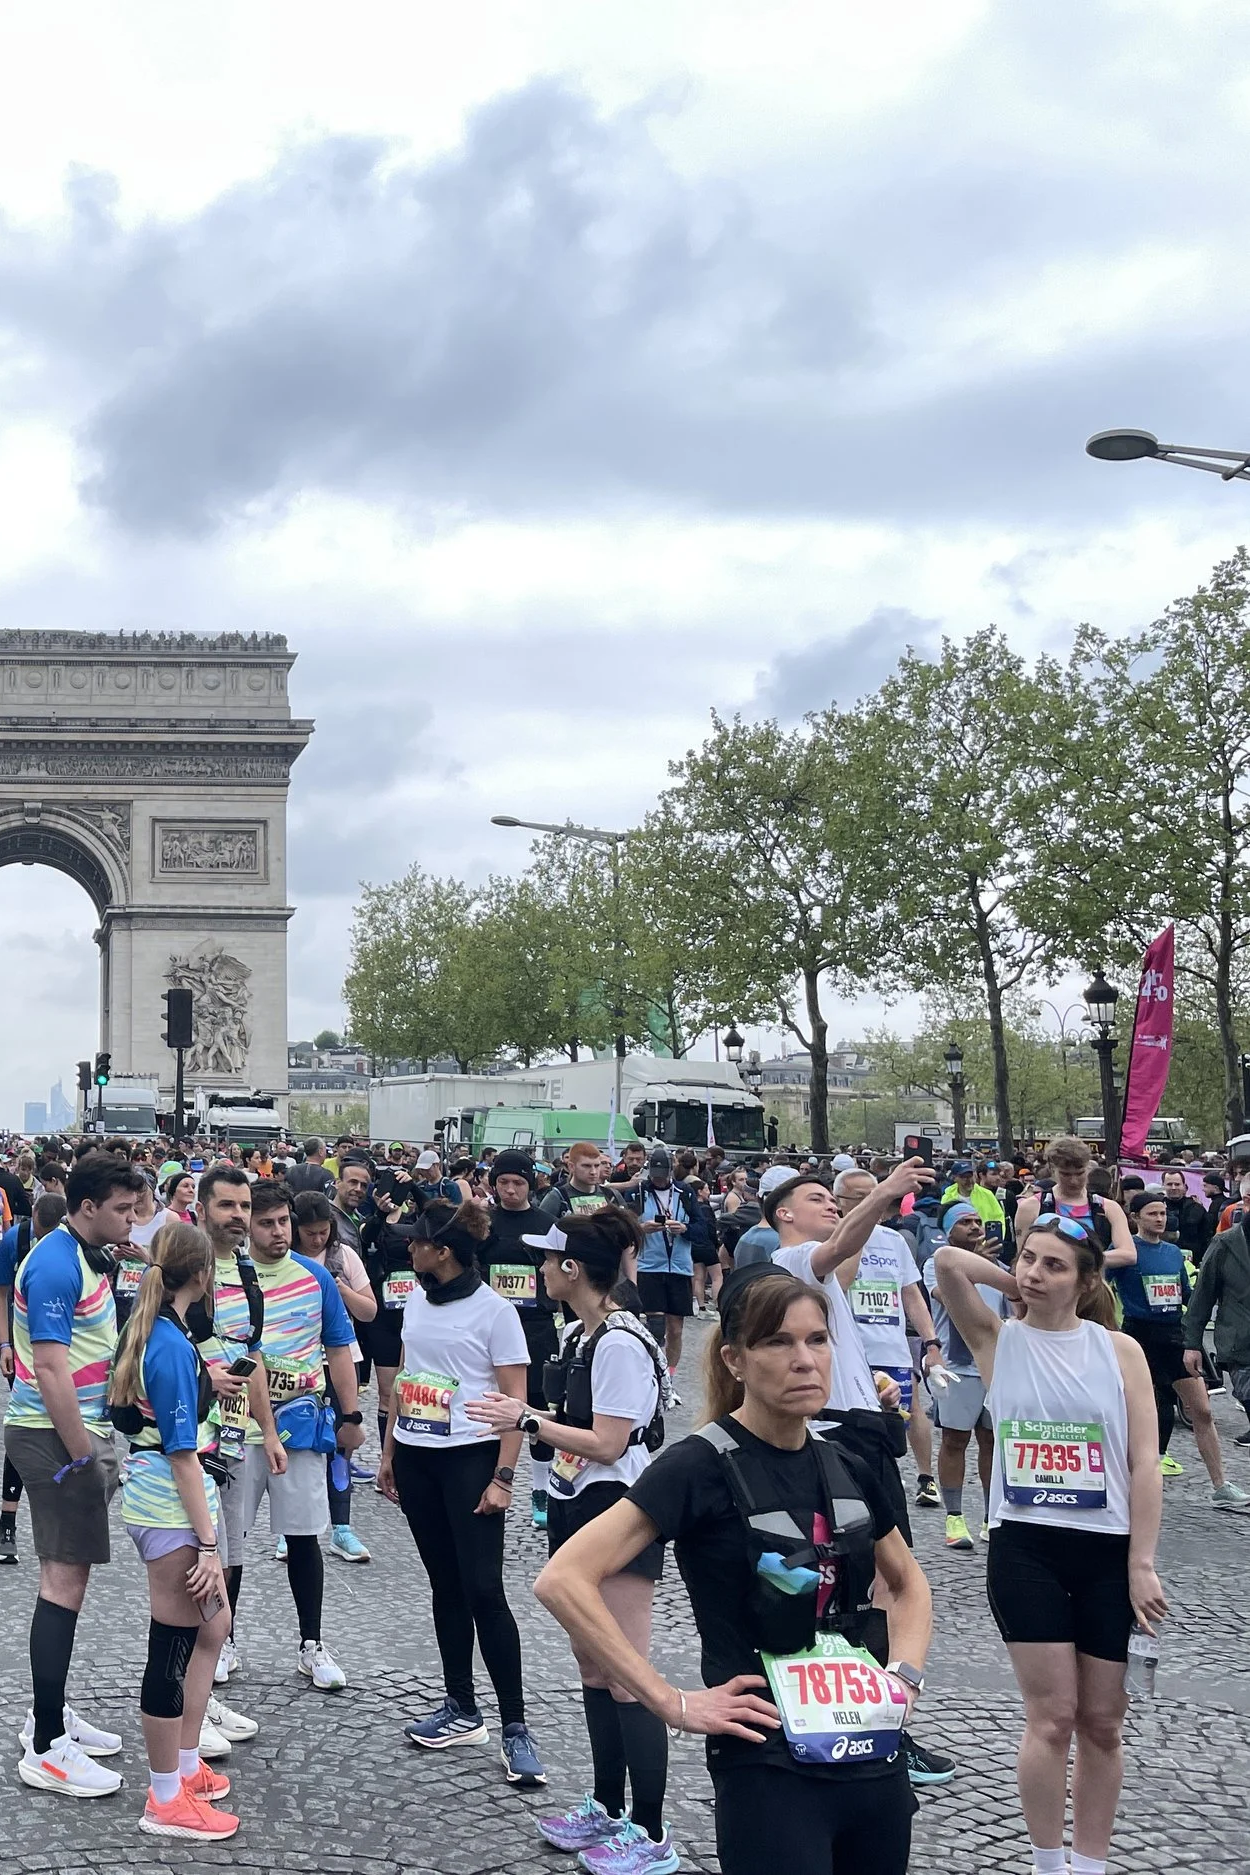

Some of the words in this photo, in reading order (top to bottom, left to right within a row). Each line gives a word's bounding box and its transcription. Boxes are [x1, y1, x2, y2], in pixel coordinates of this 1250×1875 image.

[496, 1275, 526, 1289] 70377
[858, 1291, 890, 1307] 71102
[1025, 1421, 1088, 1434] Schneider
[1013, 1443, 1082, 1473] 77335
[1047, 1493, 1078, 1504] asics
[787, 1663, 883, 1705] 78753
[832, 1711, 862, 1725] HELEN
[849, 1738, 874, 1756] asics
